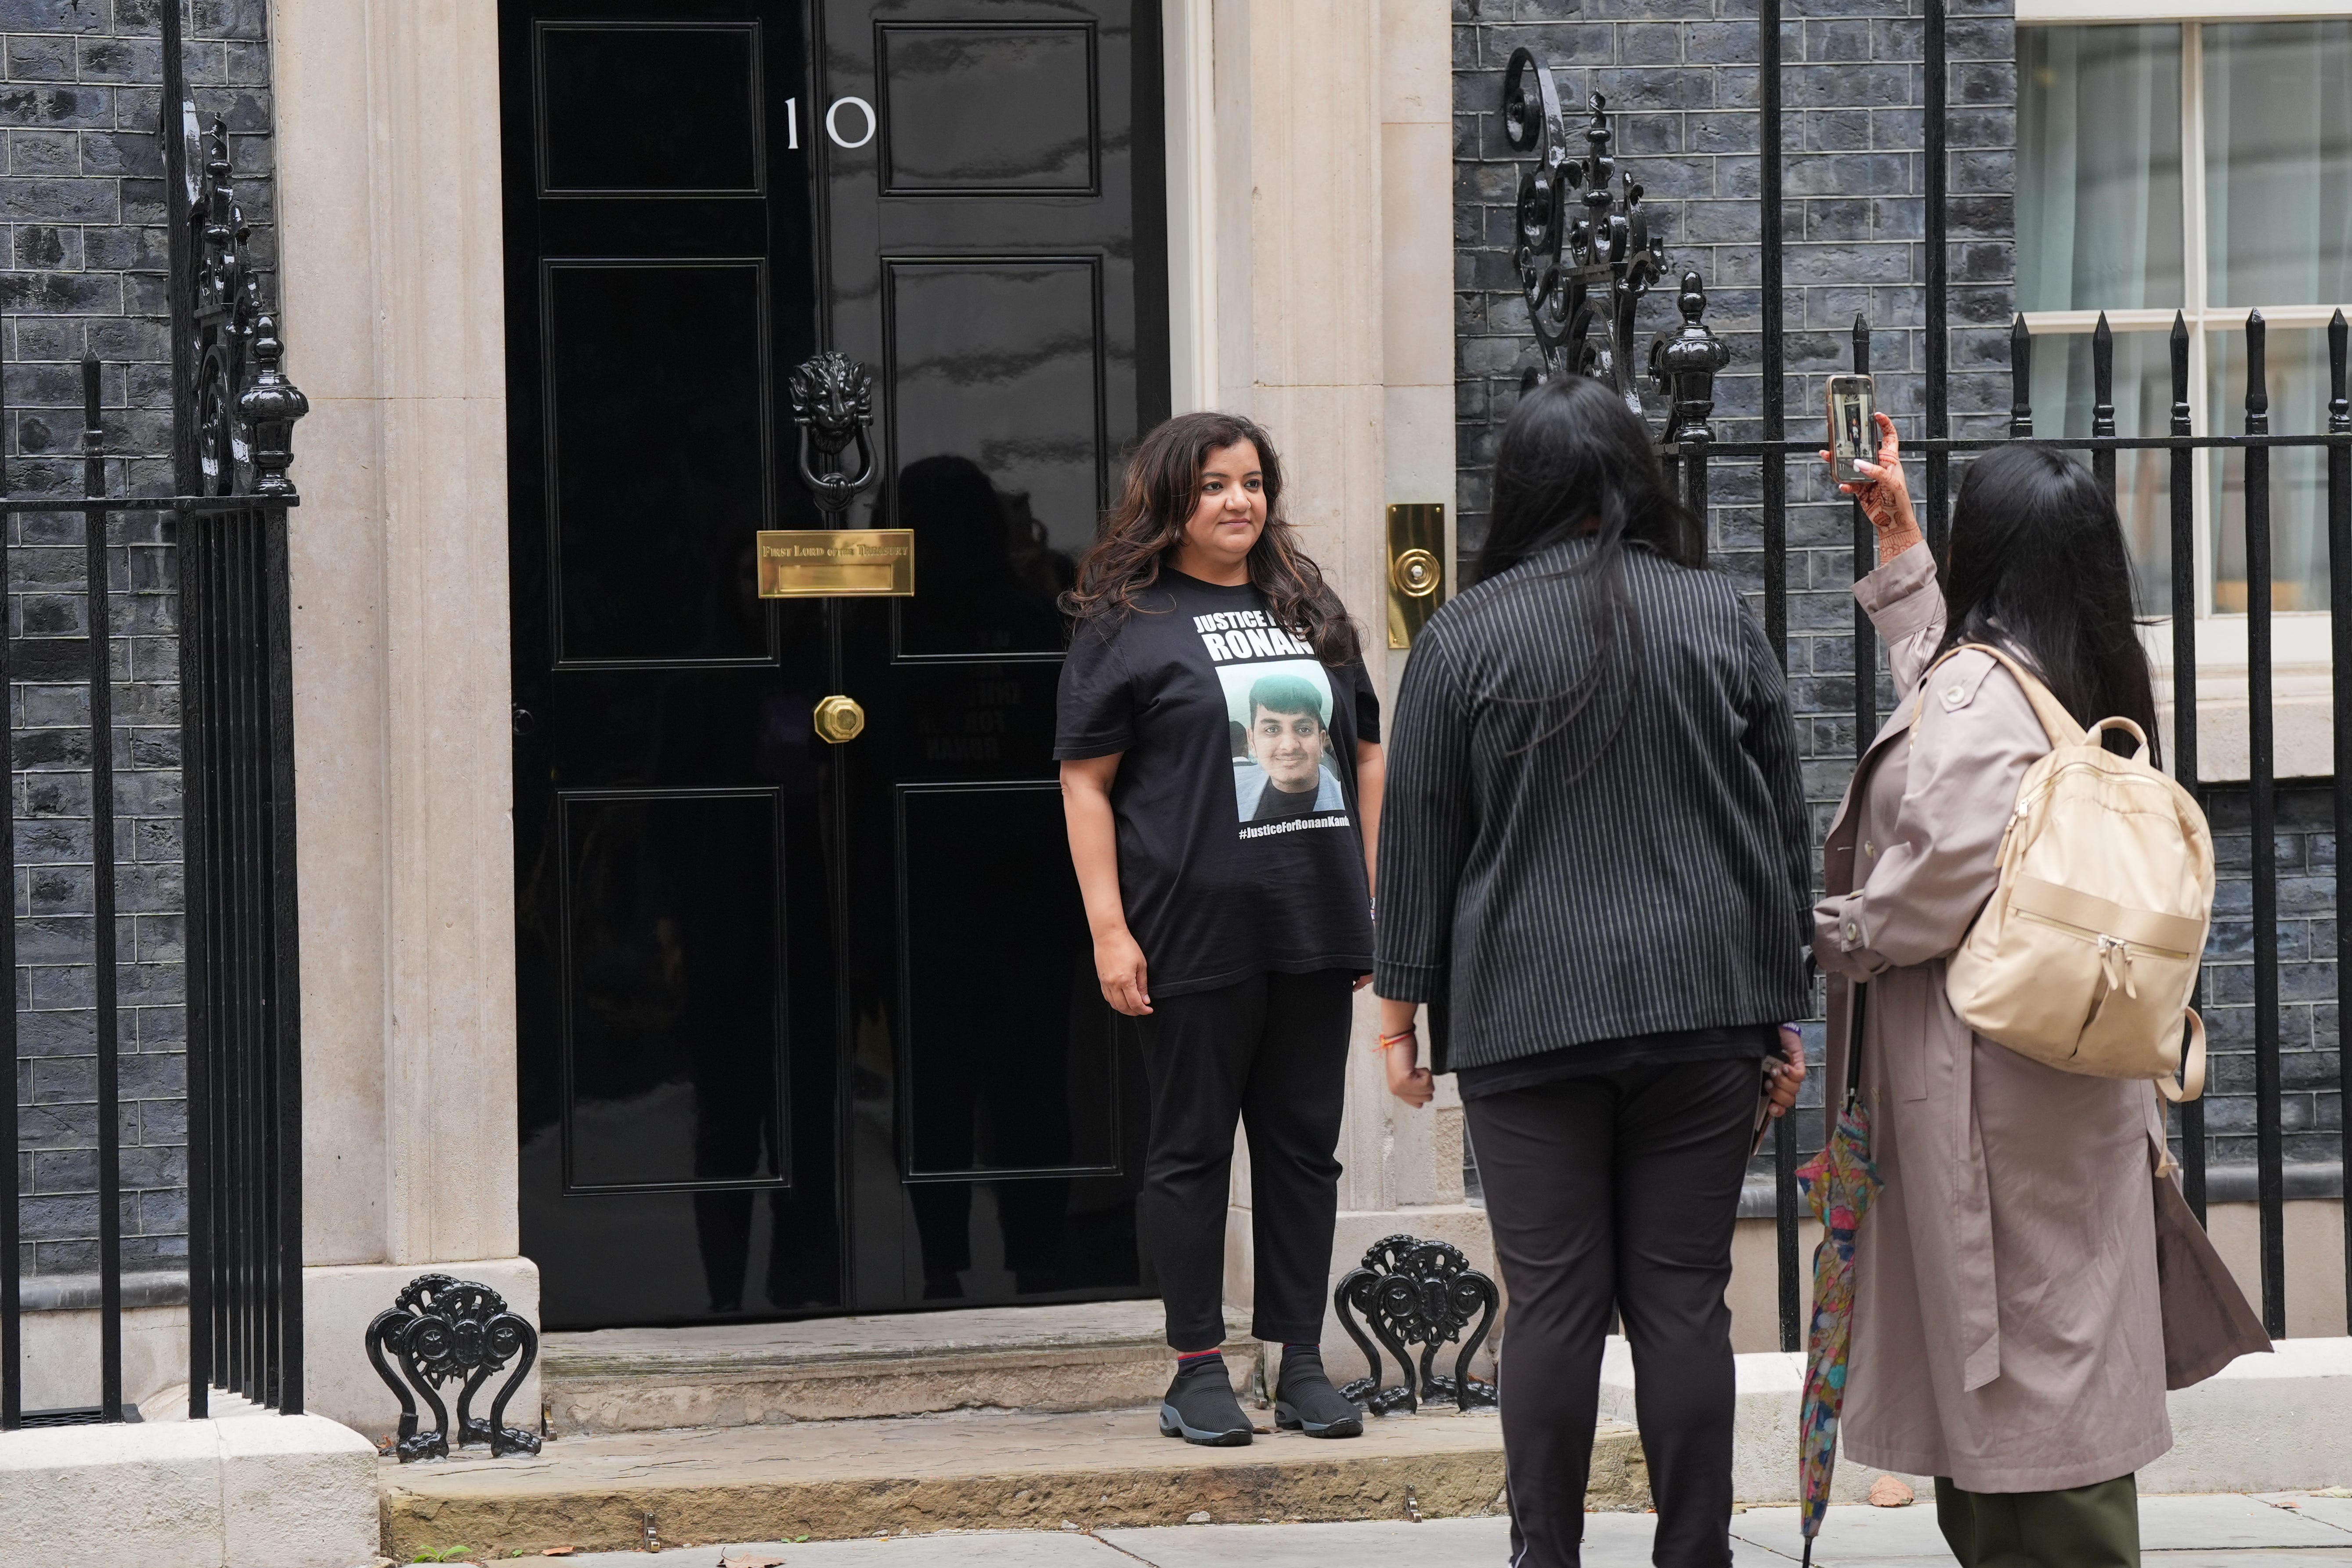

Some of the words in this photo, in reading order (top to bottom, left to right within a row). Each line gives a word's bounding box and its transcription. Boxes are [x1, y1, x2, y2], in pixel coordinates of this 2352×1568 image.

[784, 96, 876, 149] 10
[762, 546, 792, 557] FIRST
[794, 545, 824, 556] LORD
[1192, 610, 1267, 633] JUSTICE
[1201, 627, 1315, 661] RONAN
